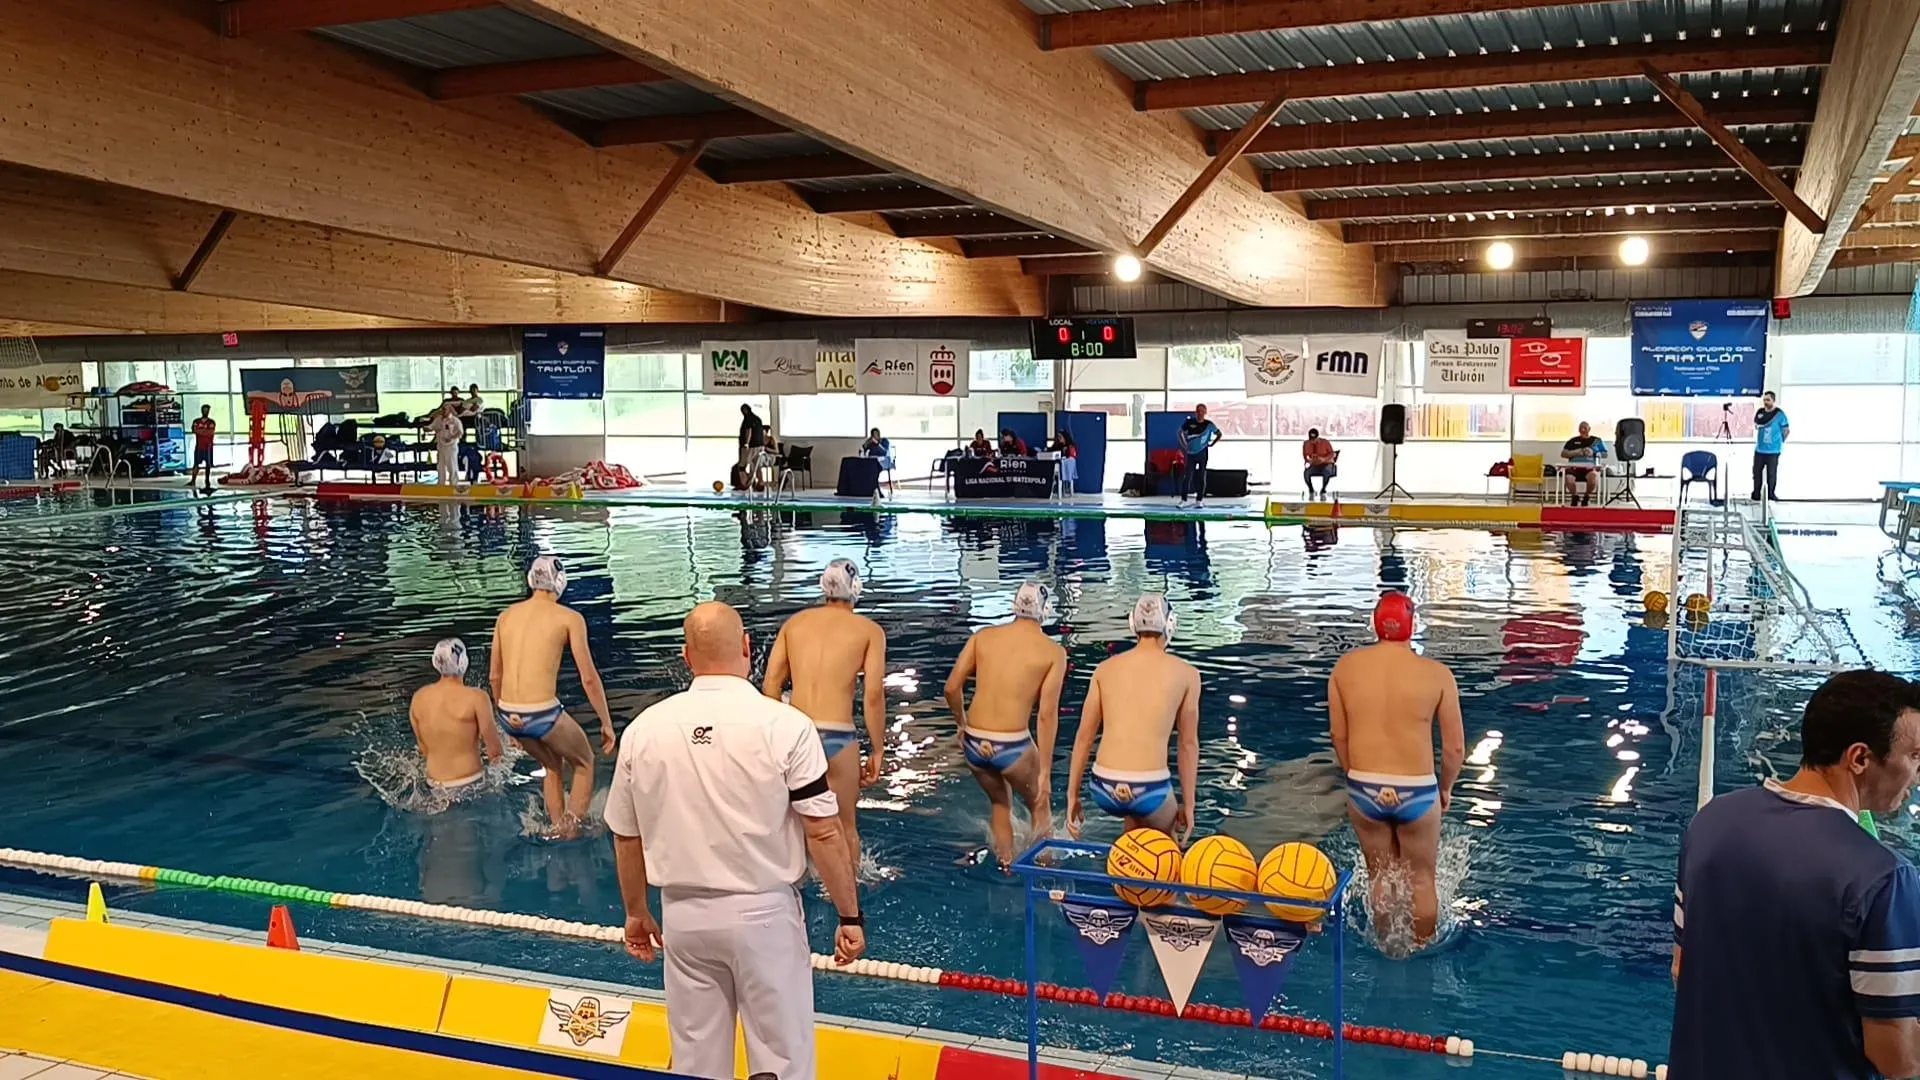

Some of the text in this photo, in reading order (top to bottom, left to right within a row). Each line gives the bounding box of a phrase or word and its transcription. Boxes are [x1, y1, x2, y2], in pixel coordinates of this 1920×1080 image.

[1059, 327, 1068, 341] 0
[1103, 326, 1113, 340] 0
[1071, 342, 1104, 356] 8:00
[1429, 341, 1500, 357] Casa Pablo
[885, 359, 914, 371] Rfen
[825, 368, 857, 388] Alc
[1441, 368, 1485, 382] Urbión
